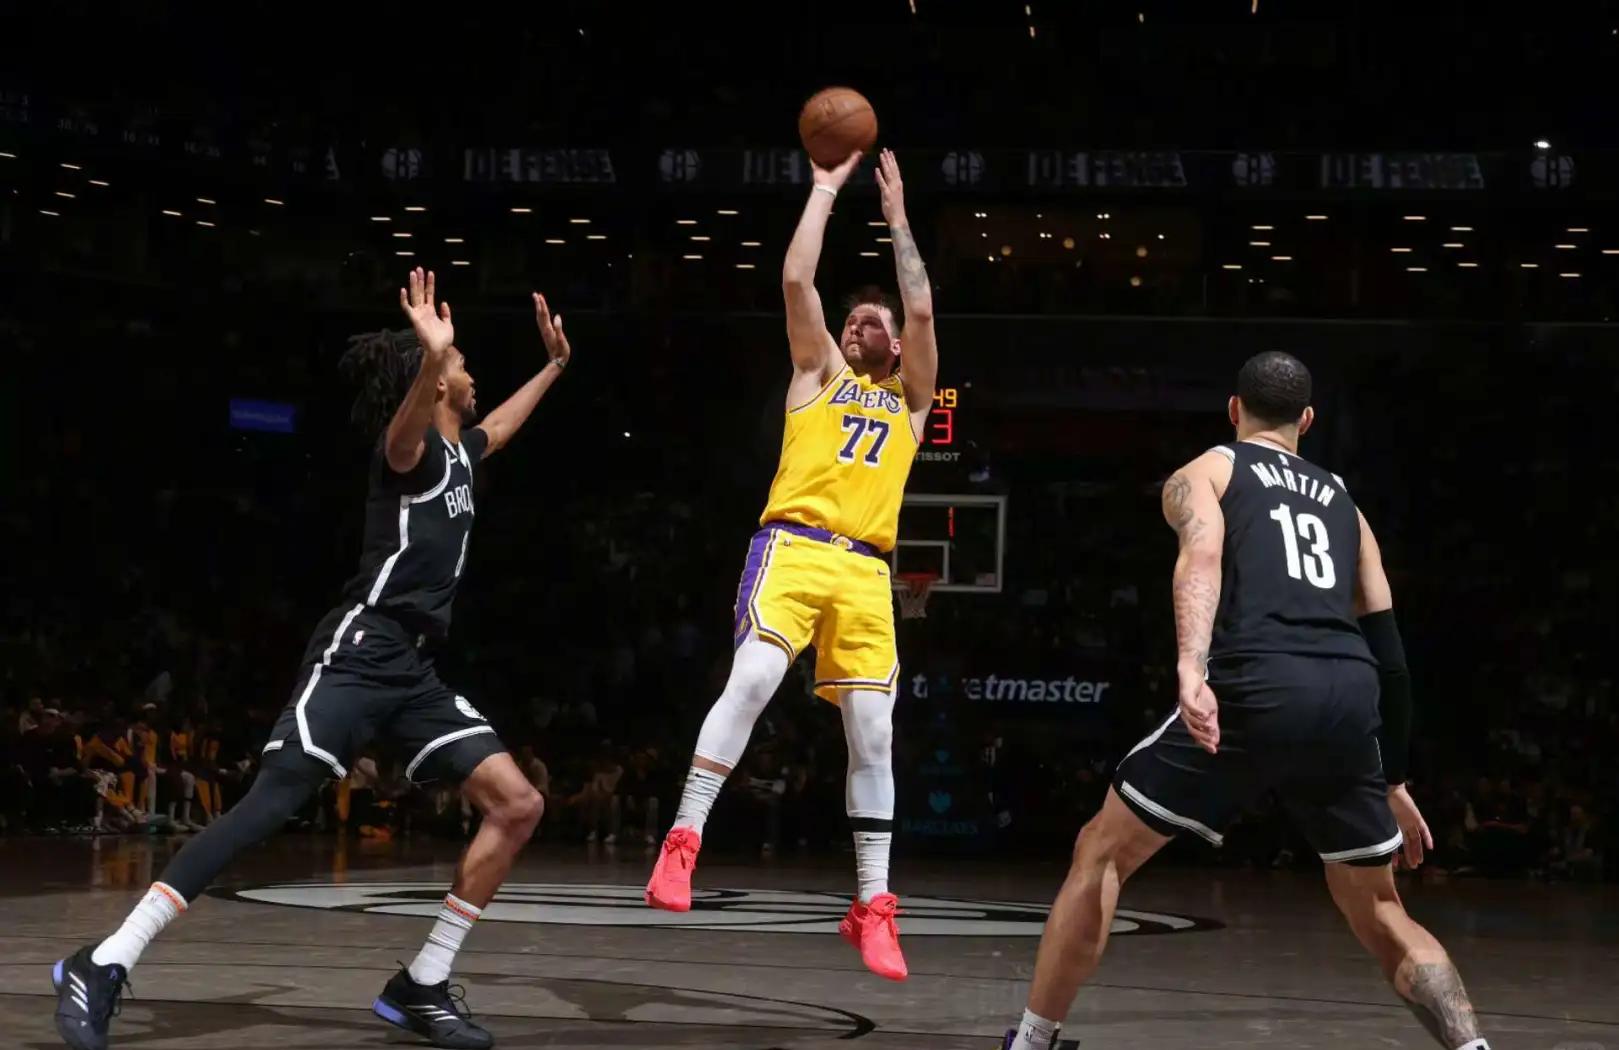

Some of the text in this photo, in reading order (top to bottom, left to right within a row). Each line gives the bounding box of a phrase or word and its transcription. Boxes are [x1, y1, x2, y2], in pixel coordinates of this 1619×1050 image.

[827, 379, 901, 414] LAERS
[932, 388, 958, 408] 49
[840, 414, 890, 466] 77
[920, 408, 953, 444] 3
[1249, 462, 1336, 508] MARTIN
[1269, 503, 1337, 589] 13
[912, 673, 1111, 704] tetmaster
